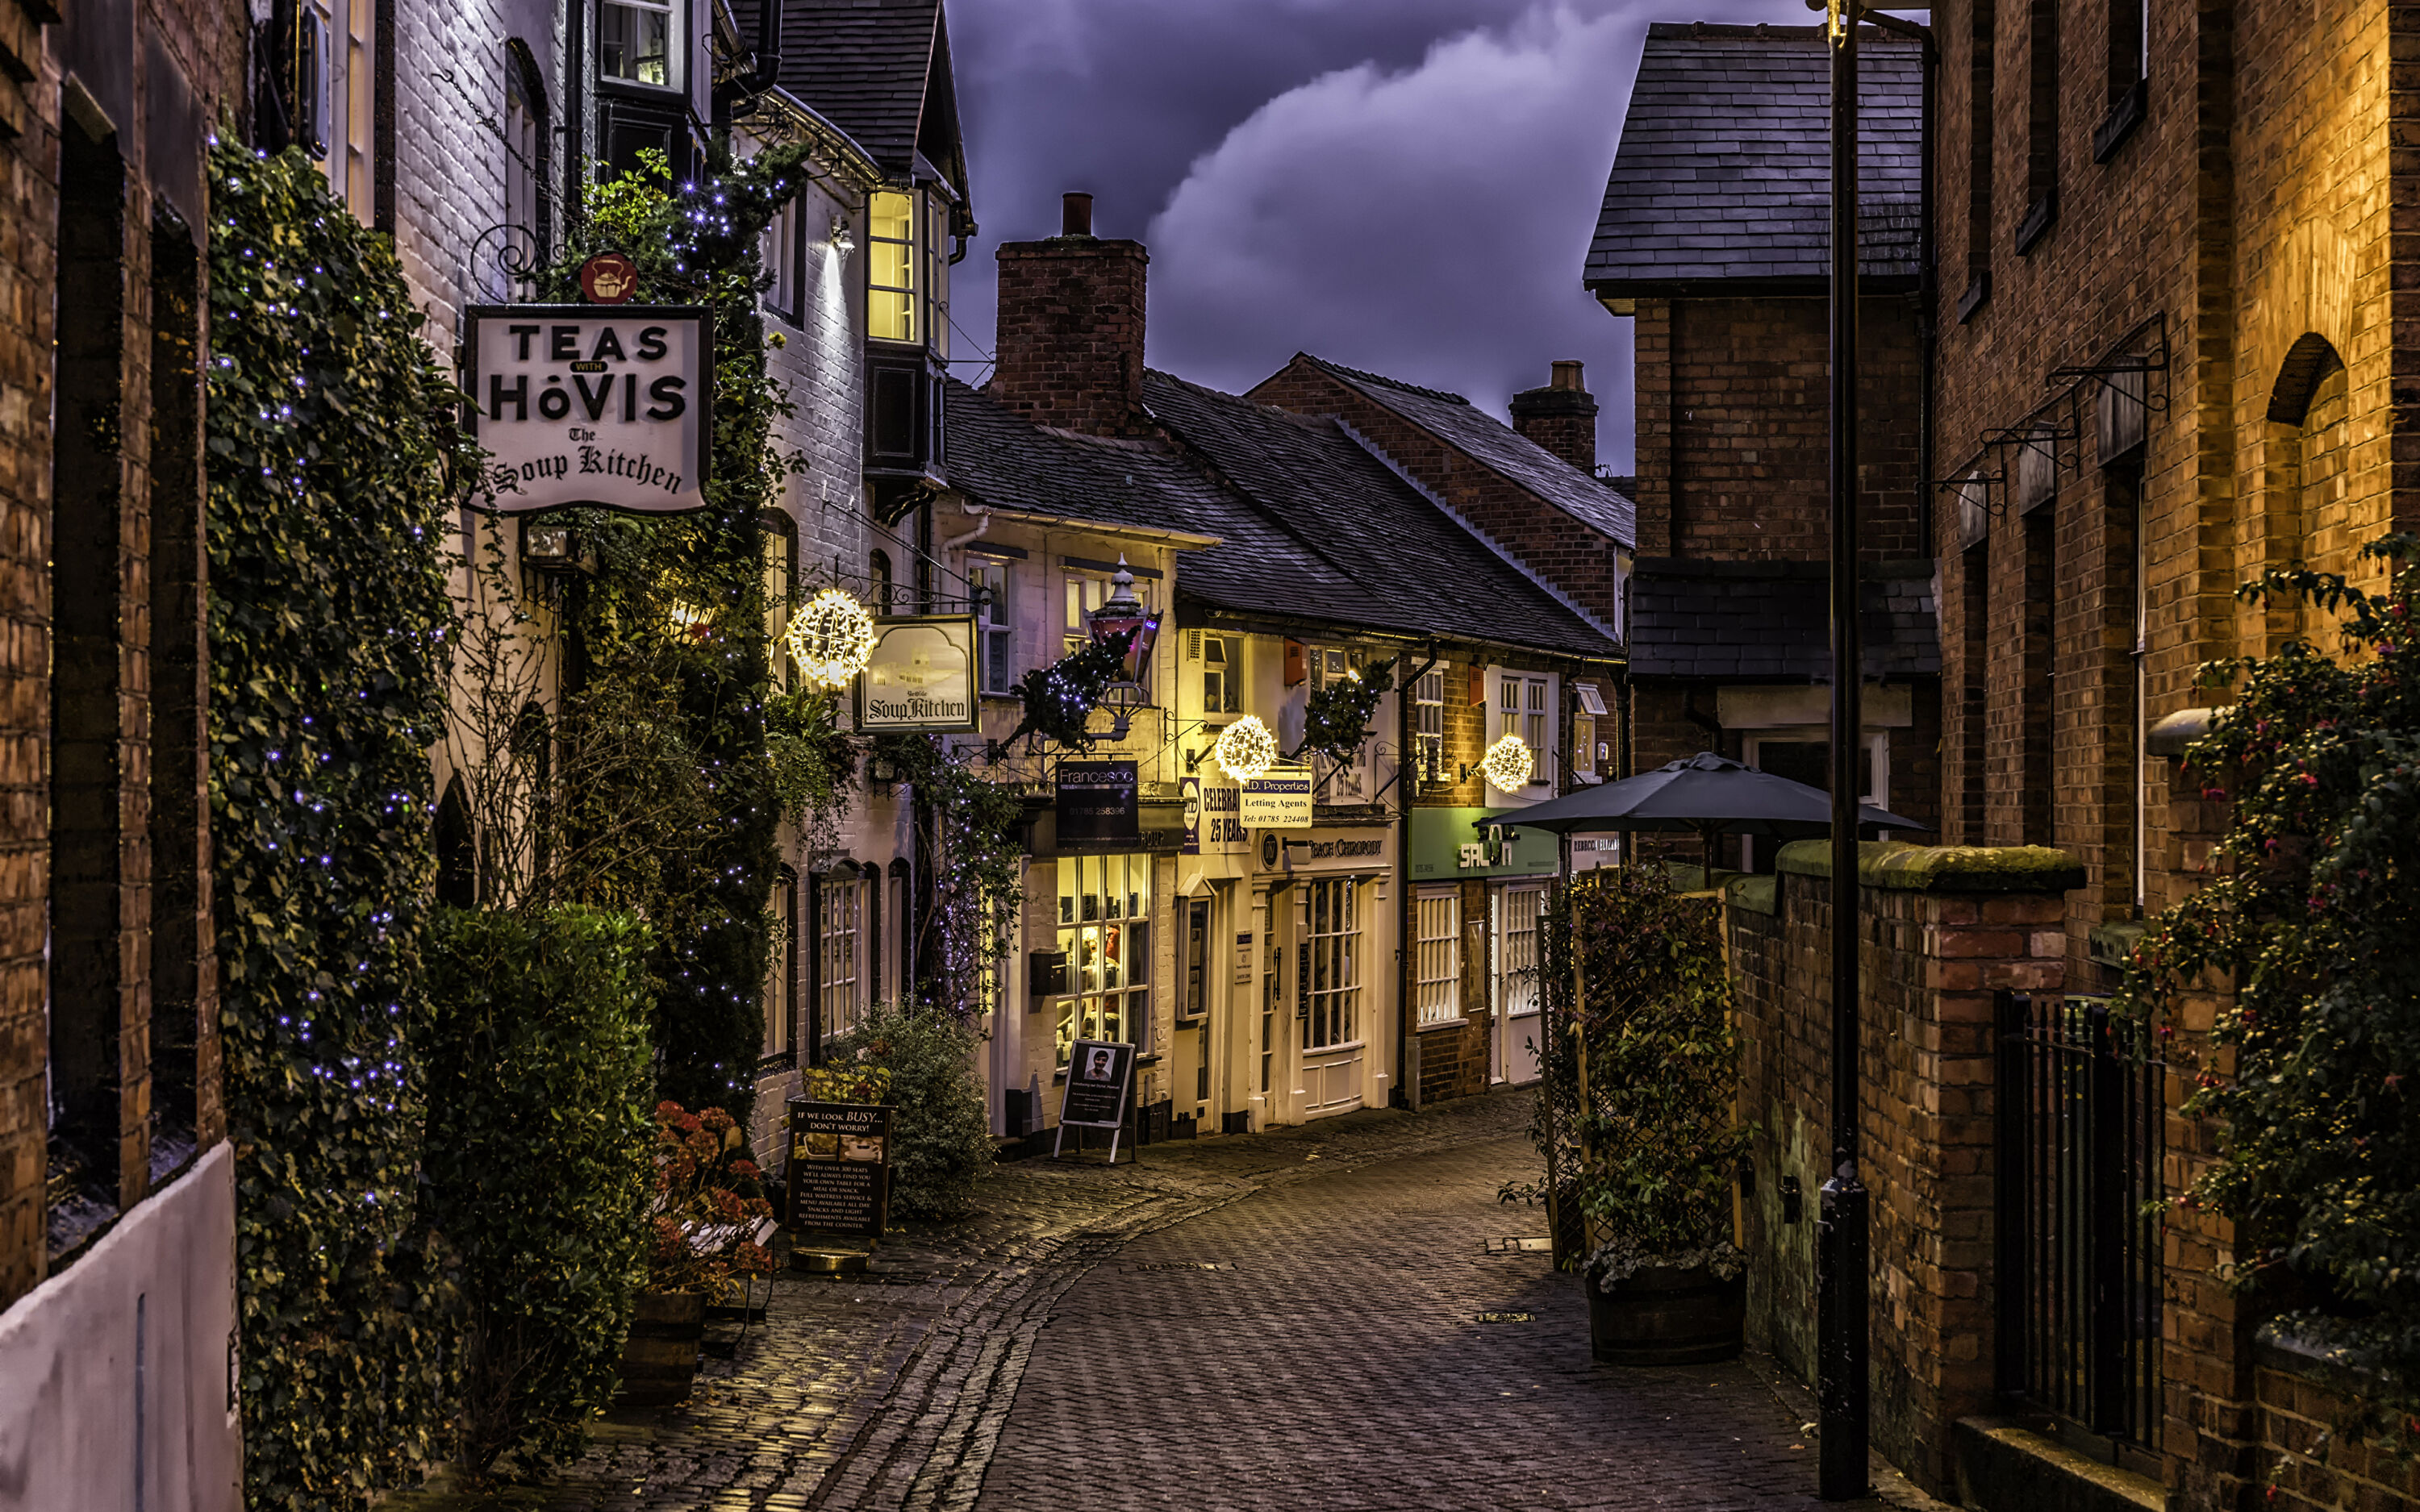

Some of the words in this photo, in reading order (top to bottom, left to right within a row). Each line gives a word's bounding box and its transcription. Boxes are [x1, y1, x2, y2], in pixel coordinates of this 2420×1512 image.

[509, 325, 668, 360] TEAS
[575, 363, 603, 371] WITH
[569, 427, 595, 443] The
[493, 455, 568, 495] Soup
[578, 445, 682, 495] Kitchen
[869, 699, 908, 721] Soup
[908, 698, 965, 721] Kitchen
[1060, 768, 1133, 783] Francesco
[1264, 781, 1309, 792] Properties
[1245, 798, 1276, 809] Letting
[1278, 799, 1308, 809] Agents
[1211, 818, 1221, 843] 25
[1223, 818, 1248, 843] YEARS
[821, 1113, 844, 1121] LOOK
[846, 1111, 883, 1123] BUSY...
[810, 1122, 837, 1130] DON'T
[838, 1124, 870, 1132] WORRY!
